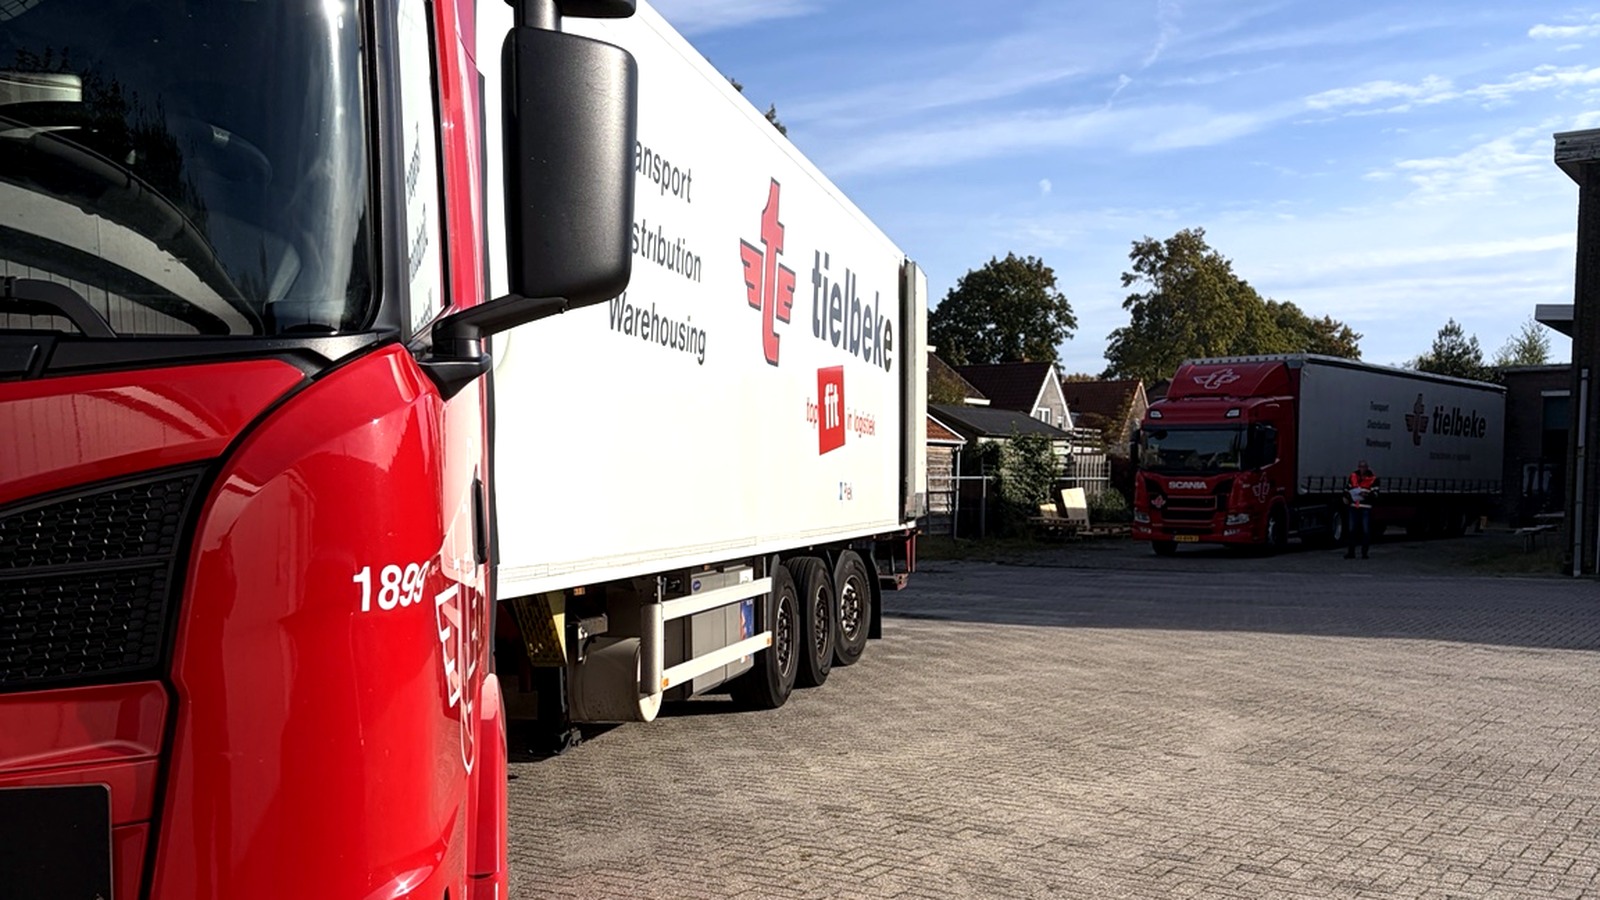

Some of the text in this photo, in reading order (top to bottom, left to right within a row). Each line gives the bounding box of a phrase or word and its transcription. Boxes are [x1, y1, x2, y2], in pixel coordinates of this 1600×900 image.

[635, 139, 692, 203] ansport
[631, 218, 702, 283] stribution
[609, 291, 706, 366] Warehousing
[812, 249, 894, 373] tielbeke
[824, 382, 839, 430] fit
[1432, 405, 1487, 439] tielbeke
[1168, 481, 1208, 490] SCANIA
[353, 560, 431, 612] 1899
